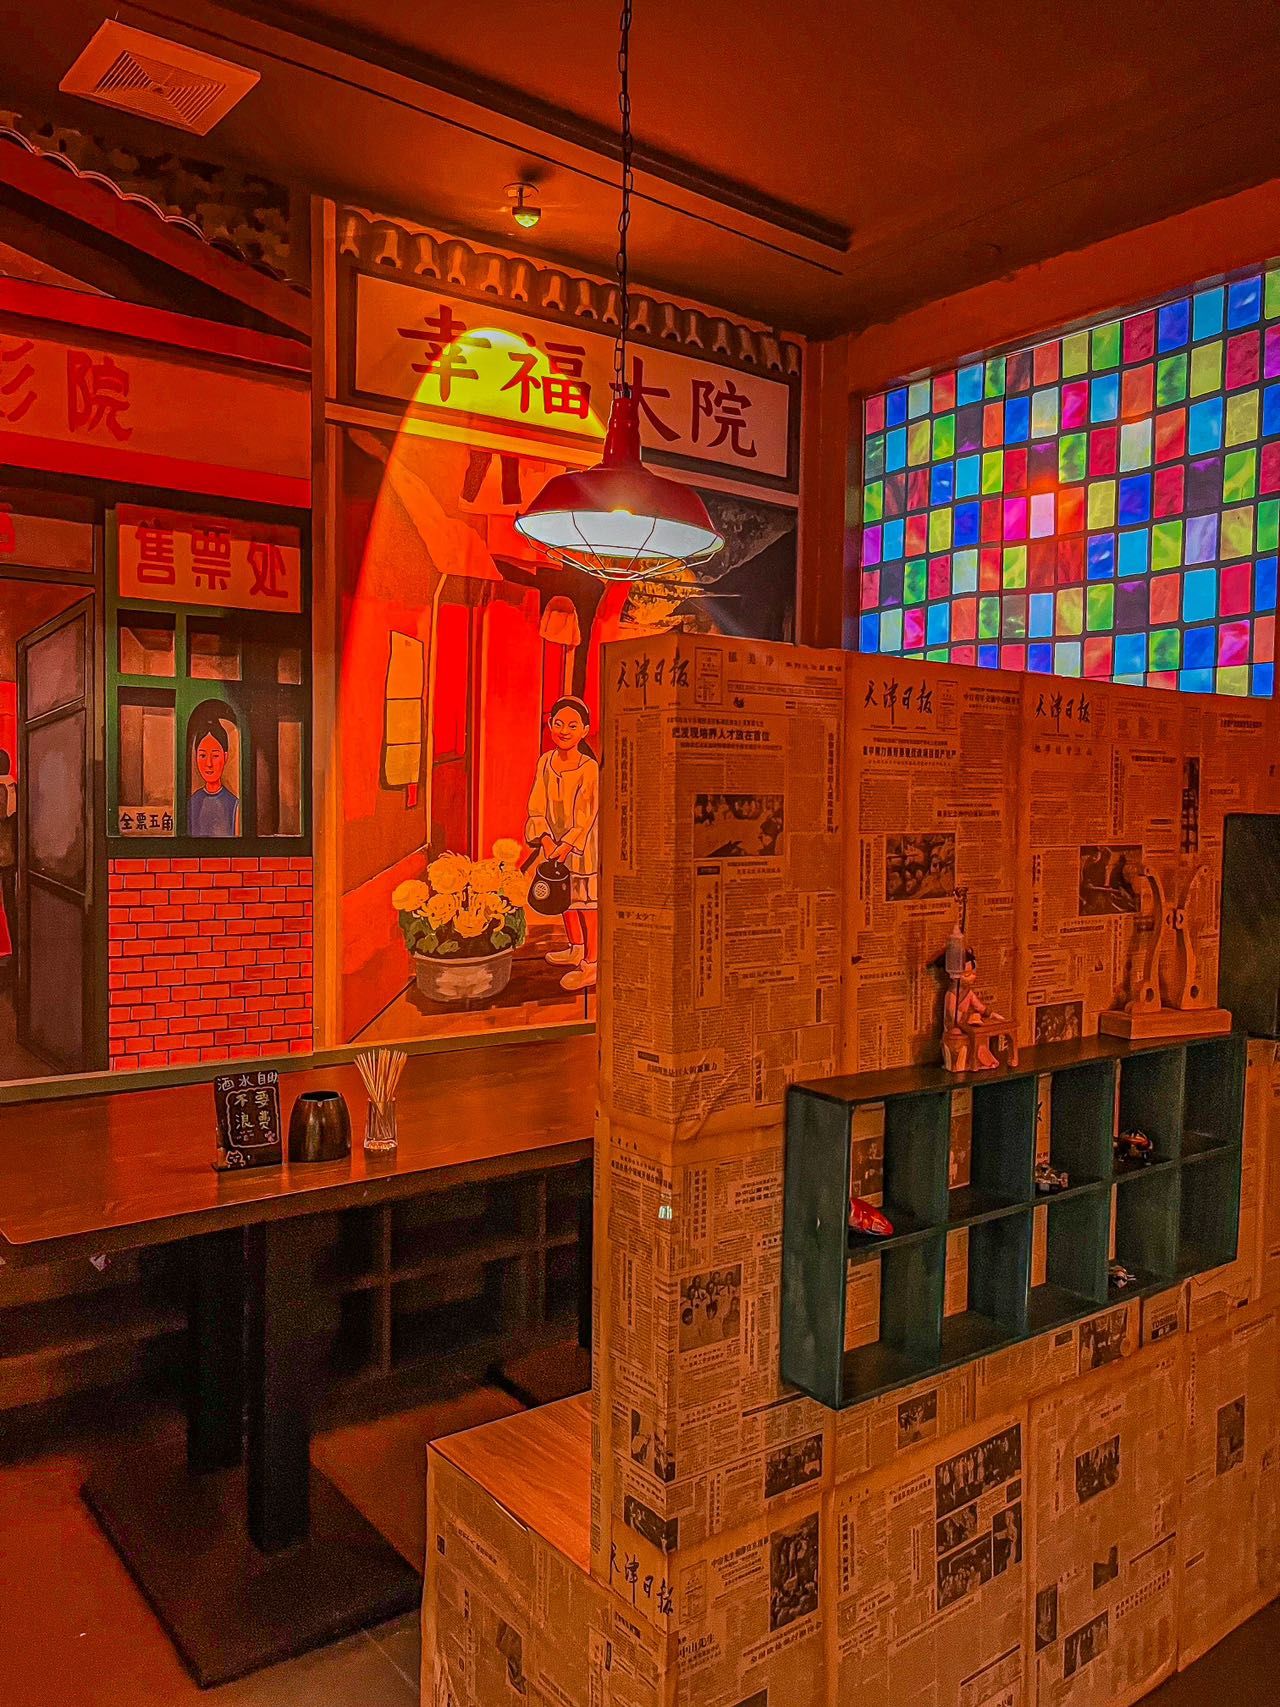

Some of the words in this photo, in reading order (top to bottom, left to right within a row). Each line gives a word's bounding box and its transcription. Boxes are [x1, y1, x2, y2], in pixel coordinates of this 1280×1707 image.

[397, 303, 758, 458] 幸福大院
[134, 517, 289, 599] 售票处
[616, 648, 690, 706] 天津日报
[863, 677, 934, 725] 天津日报
[1034, 691, 1092, 733] 天津日报
[119, 811, 174, 831] 全票五角
